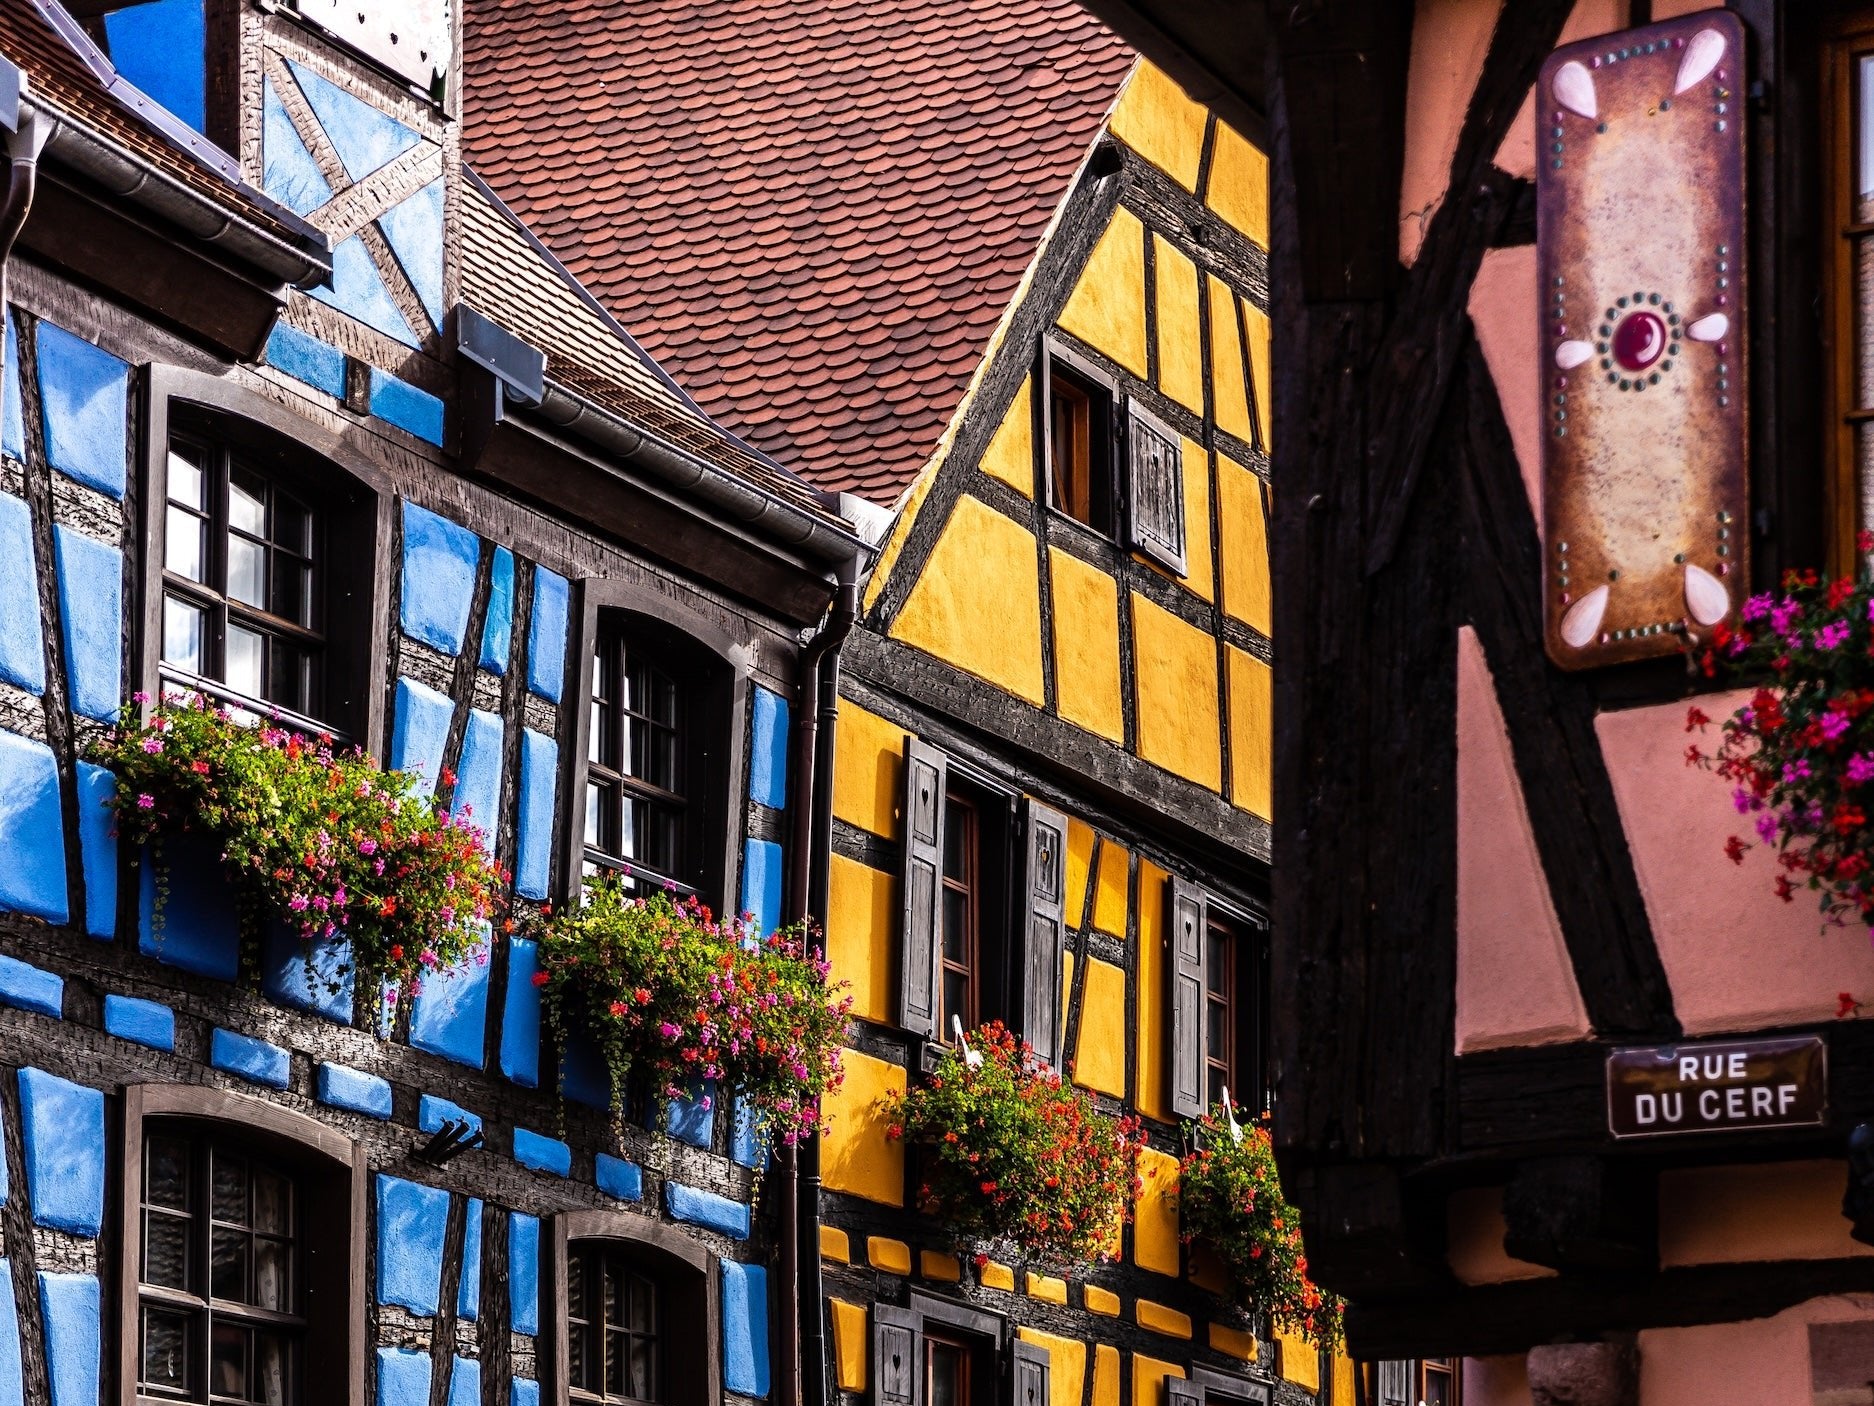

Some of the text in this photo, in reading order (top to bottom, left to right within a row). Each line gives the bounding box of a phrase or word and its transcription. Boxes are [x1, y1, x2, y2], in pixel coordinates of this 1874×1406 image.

[1679, 1053, 1747, 1081] RUE
[1635, 1084, 1798, 1124] DU CERF
